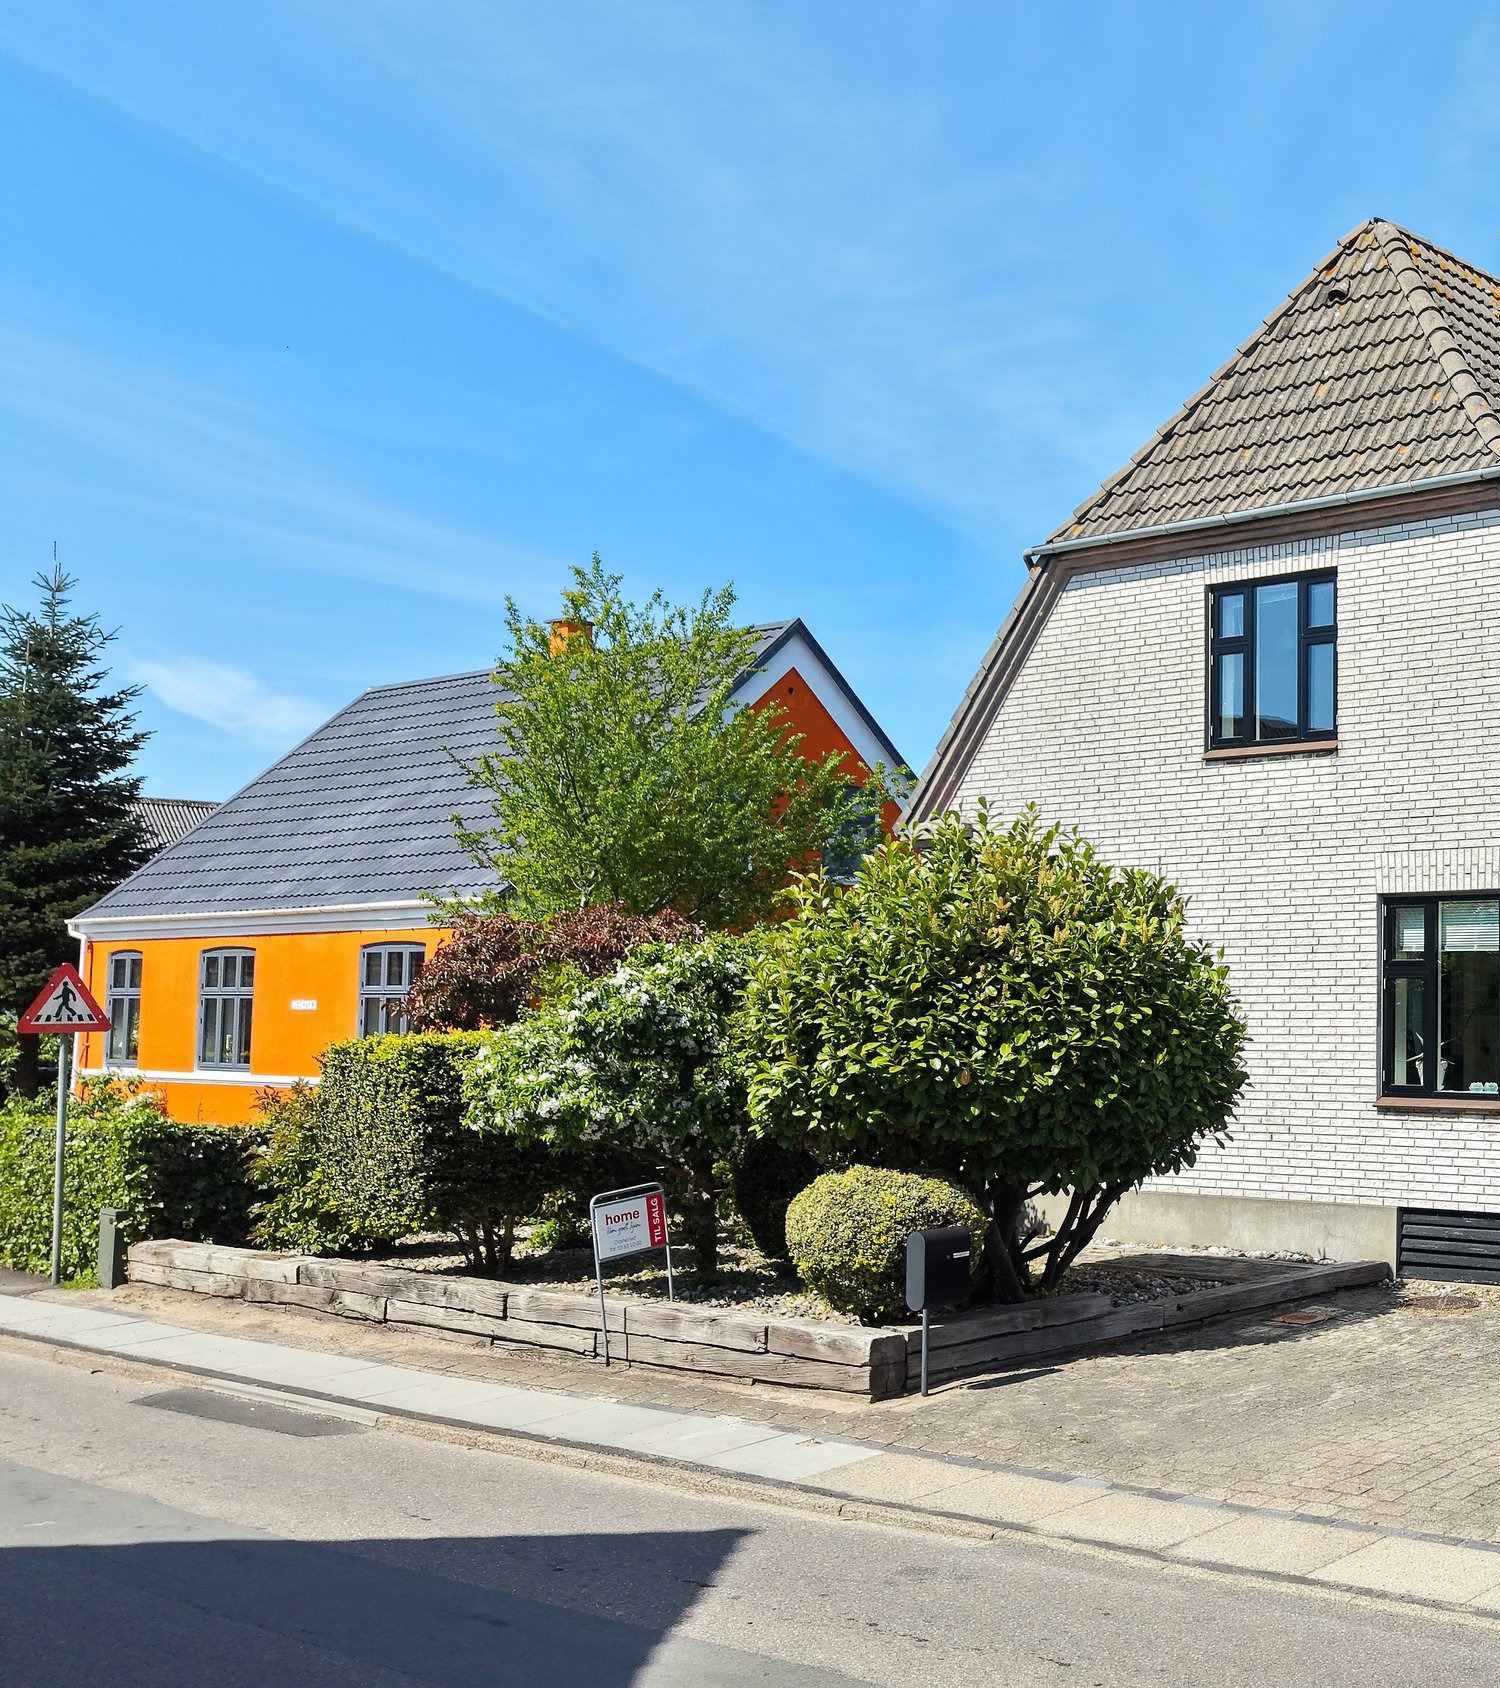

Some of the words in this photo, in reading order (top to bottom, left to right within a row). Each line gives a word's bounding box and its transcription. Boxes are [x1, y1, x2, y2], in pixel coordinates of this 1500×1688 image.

[605, 1210, 640, 1226] home
[651, 1197, 661, 1225] SALG
[653, 1226, 662, 1243] TIL
